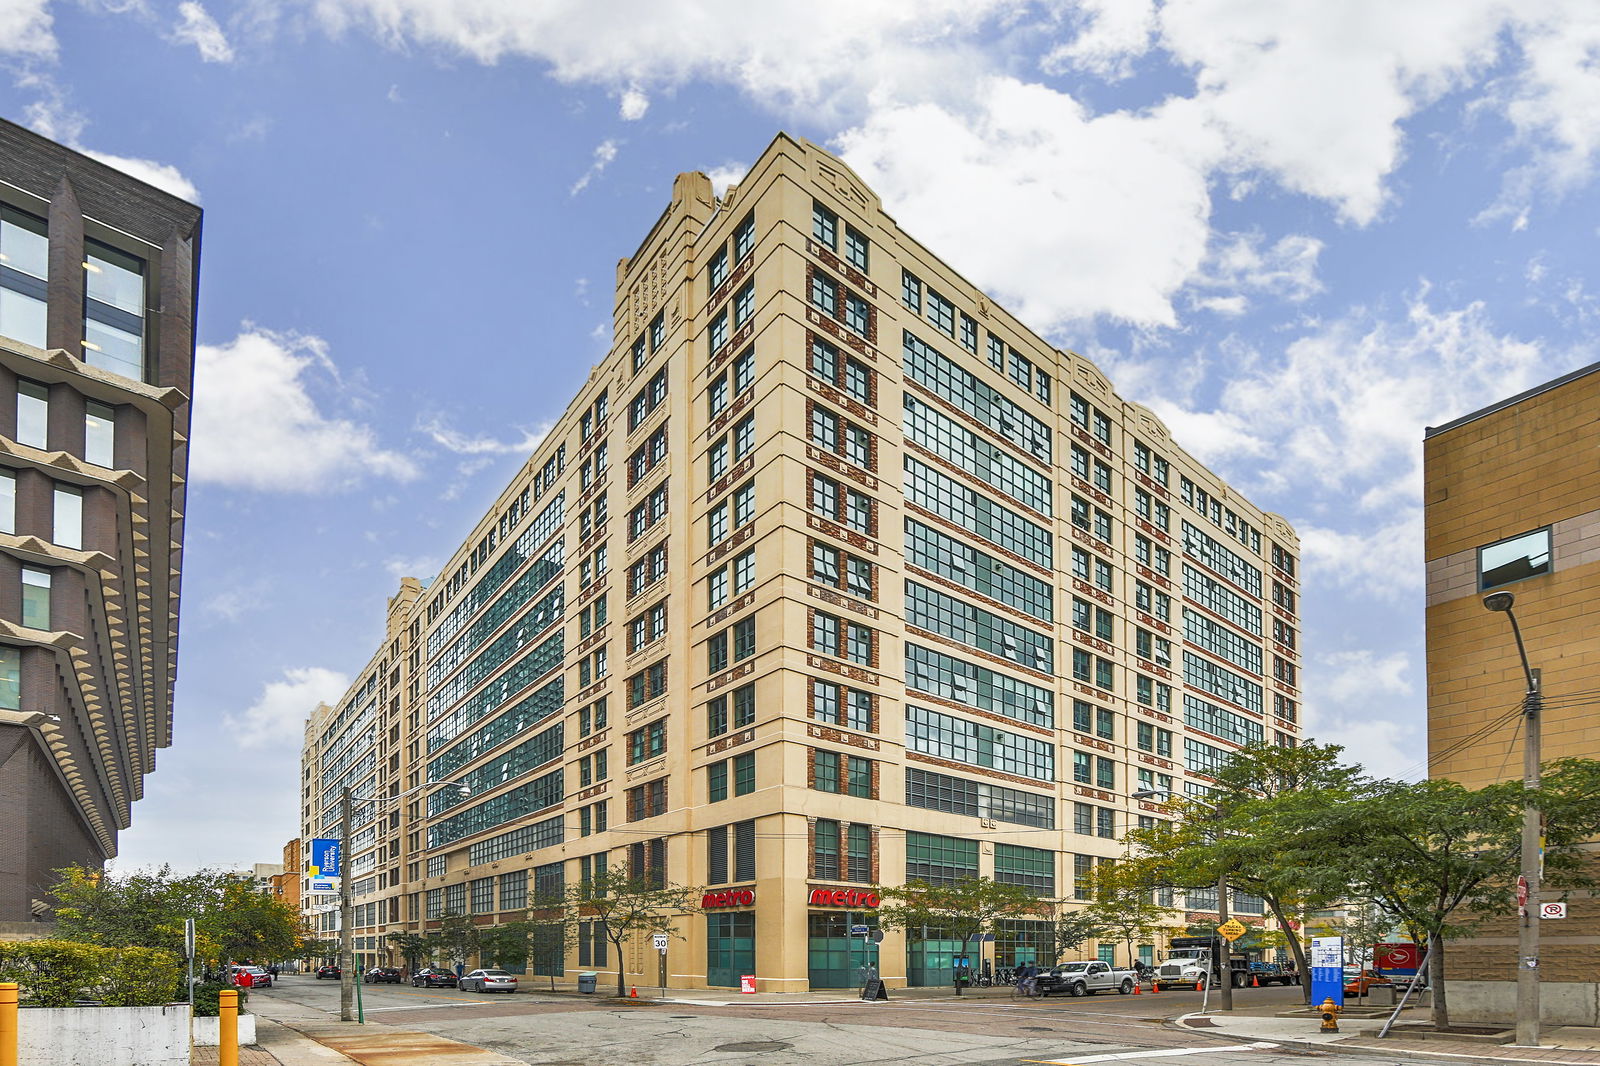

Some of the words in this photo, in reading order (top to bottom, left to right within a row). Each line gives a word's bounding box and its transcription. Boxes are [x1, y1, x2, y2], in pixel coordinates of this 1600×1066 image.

[702, 889, 754, 908] metro
[809, 889, 880, 907] metro
[655, 939, 666, 947] 30
